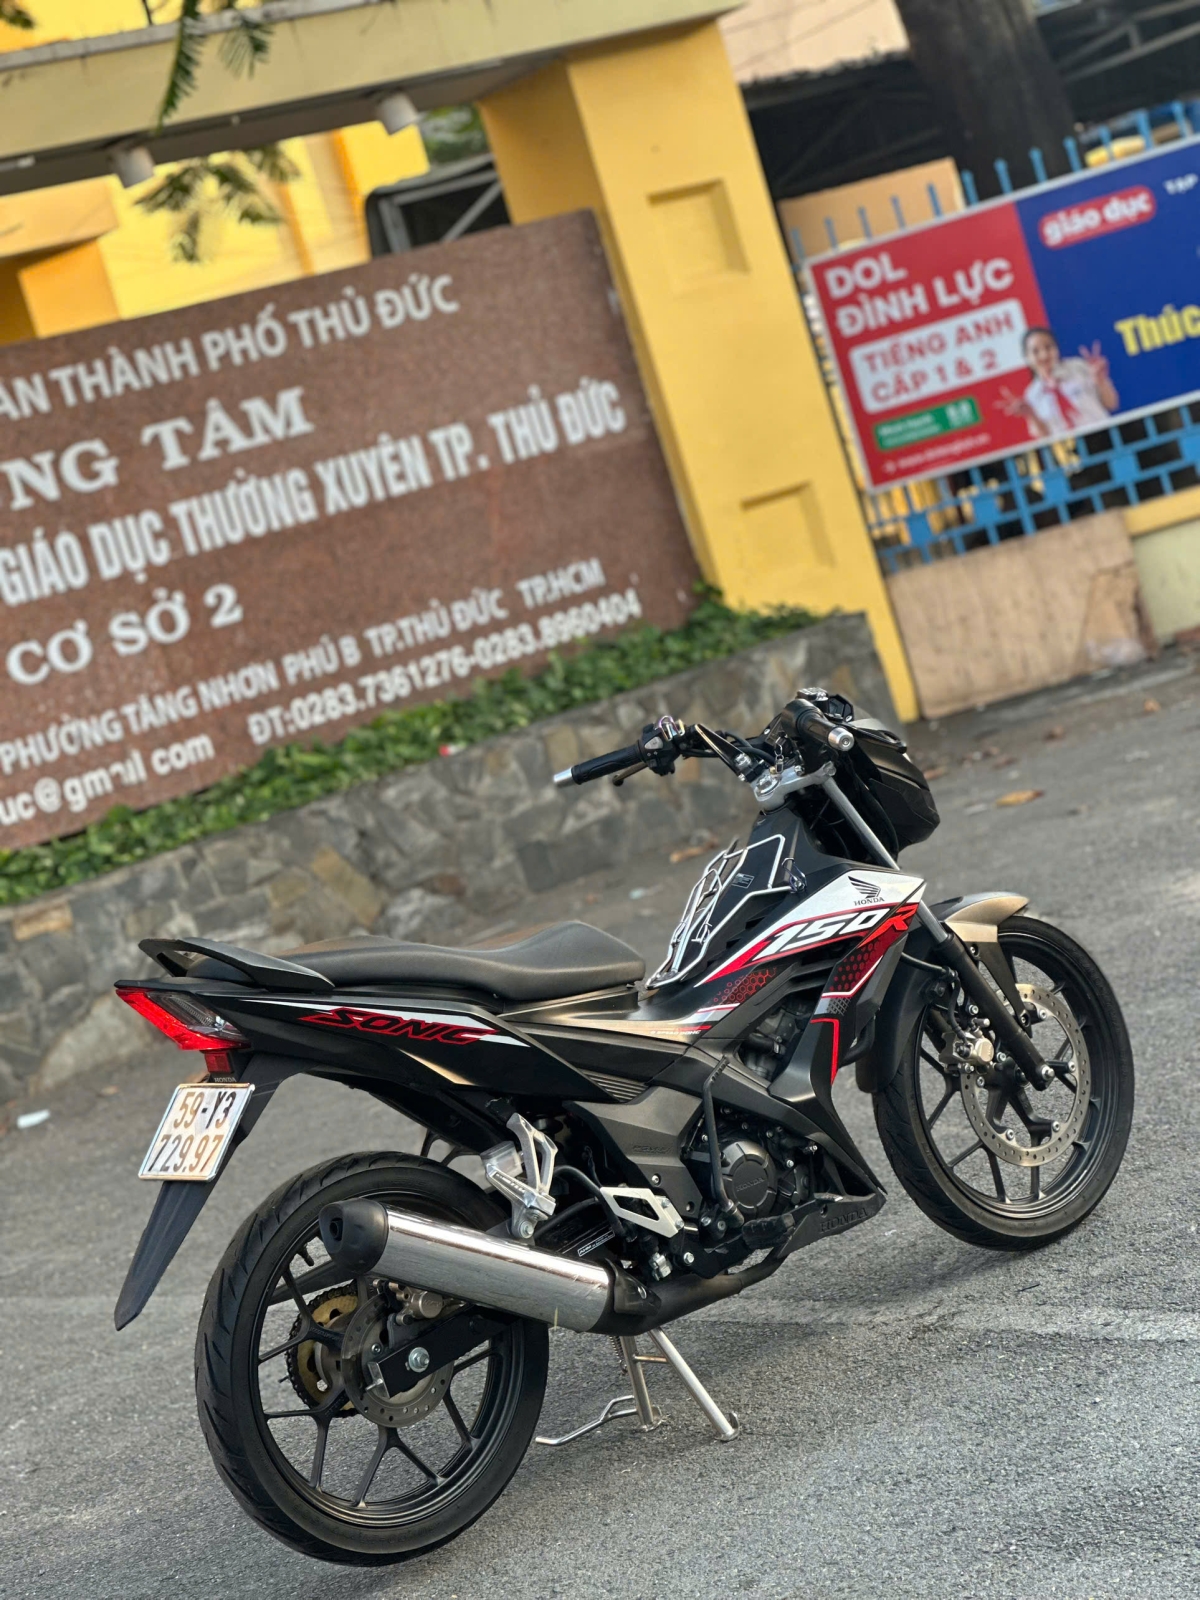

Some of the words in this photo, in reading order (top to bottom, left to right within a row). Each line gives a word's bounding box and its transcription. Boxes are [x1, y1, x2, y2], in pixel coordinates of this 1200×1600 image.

[824, 251, 908, 300] DOL
[835, 283, 930, 339] ĐÌNH
[932, 257, 1015, 307] LỰC
[48, 337, 201, 408] THÀNH
[200, 302, 288, 371] PHỐ
[287, 285, 372, 348] THỦ
[373, 272, 460, 329] ĐỨC
[862, 330, 947, 373] TIẾNG
[955, 310, 1015, 347] ANH
[870, 368, 929, 403] CẤP
[934, 364, 948, 384] 1
[954, 356, 973, 379] &
[979, 348, 998, 371] 2
[1, 437, 120, 511] NG
[140, 385, 316, 471] TÂM
[0, 526, 89, 607] GIÁO
[87, 508, 171, 583] DỤC
[168, 466, 319, 556] THƯỜNG
[313, 431, 433, 516] XUYÊN
[428, 422, 490, 481] TP.
[487, 384, 559, 464] THỦ
[555, 376, 627, 446] ĐỨC
[6, 619, 93, 686] CƠ
[108, 587, 191, 657] SỞ
[203, 583, 244, 628] 2
[1, 709, 124, 775] PHƯỜNG
[338, 634, 362, 668] B
[853, 896, 885, 907] HONDA
[298, 1006, 500, 1046] SONIC
[173, 1091, 237, 1129] 59-Y3
[148, 1134, 224, 1172] 729.97
[820, 1207, 869, 1233] HONDA
